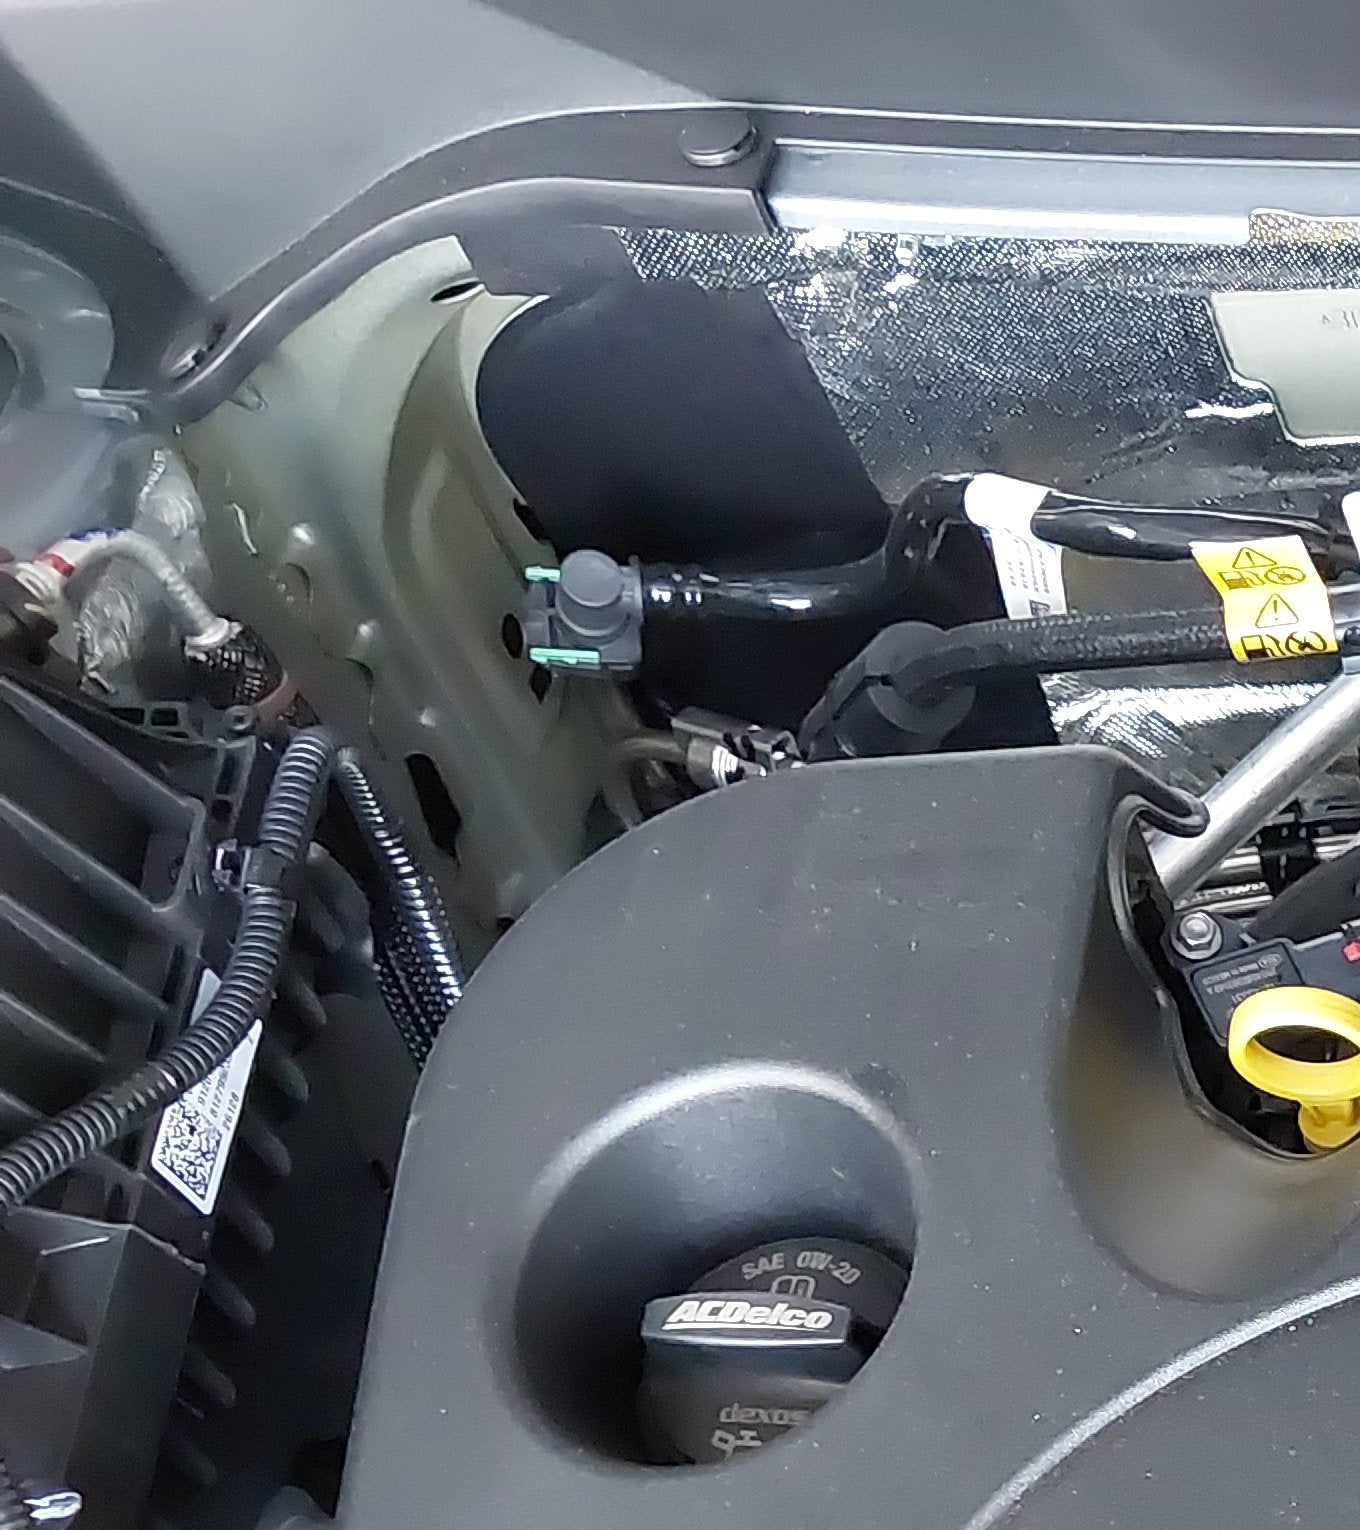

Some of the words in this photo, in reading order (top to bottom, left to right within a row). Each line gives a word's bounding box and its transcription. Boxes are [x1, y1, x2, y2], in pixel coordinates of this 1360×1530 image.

[741, 1252, 786, 1281] SAE
[796, 1250, 861, 1285] 0W-20
[665, 1300, 834, 1330] ACDelco
